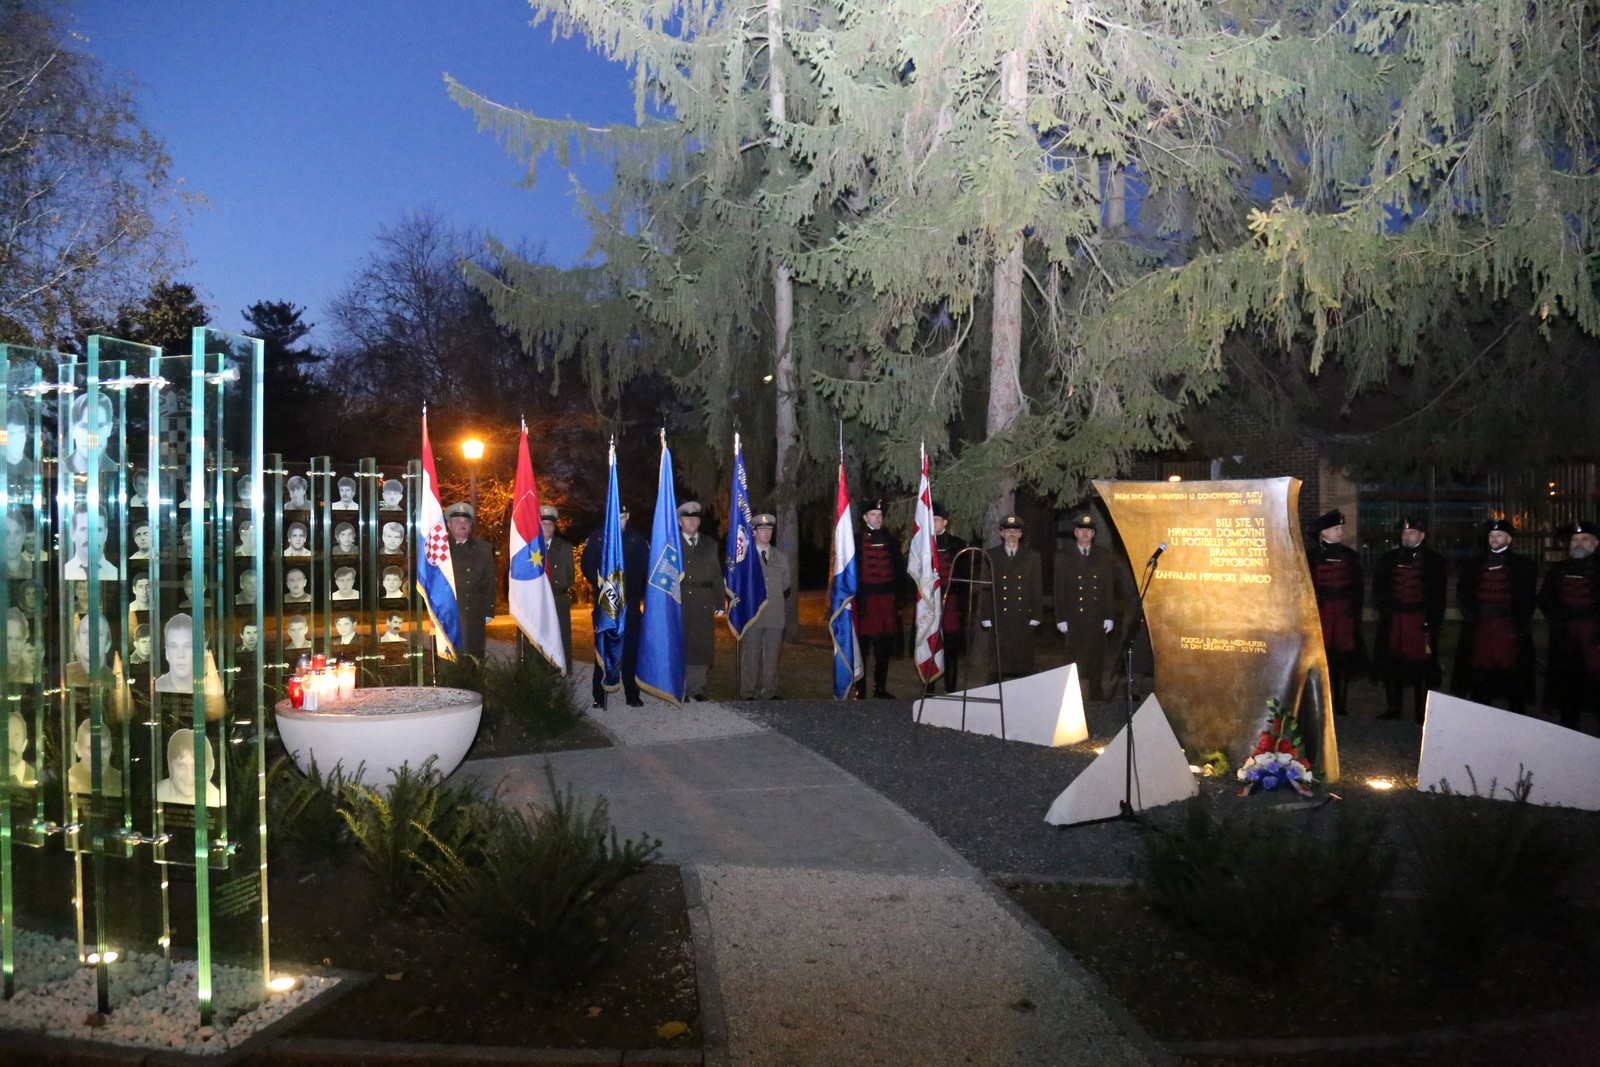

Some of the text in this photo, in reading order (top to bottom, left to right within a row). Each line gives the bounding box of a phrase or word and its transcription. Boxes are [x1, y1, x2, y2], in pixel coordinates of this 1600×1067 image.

[1246, 491, 1263, 499] RATU
[1216, 518, 1265, 527] BILI STE VI
[1167, 527, 1265, 537] HRVATSKOJ DOMOVINI
[1170, 537, 1178, 546] U
[1209, 547, 1237, 557] BRANA
[1155, 570, 1272, 584] ZAHVALAN HRVATSKI NAROD
